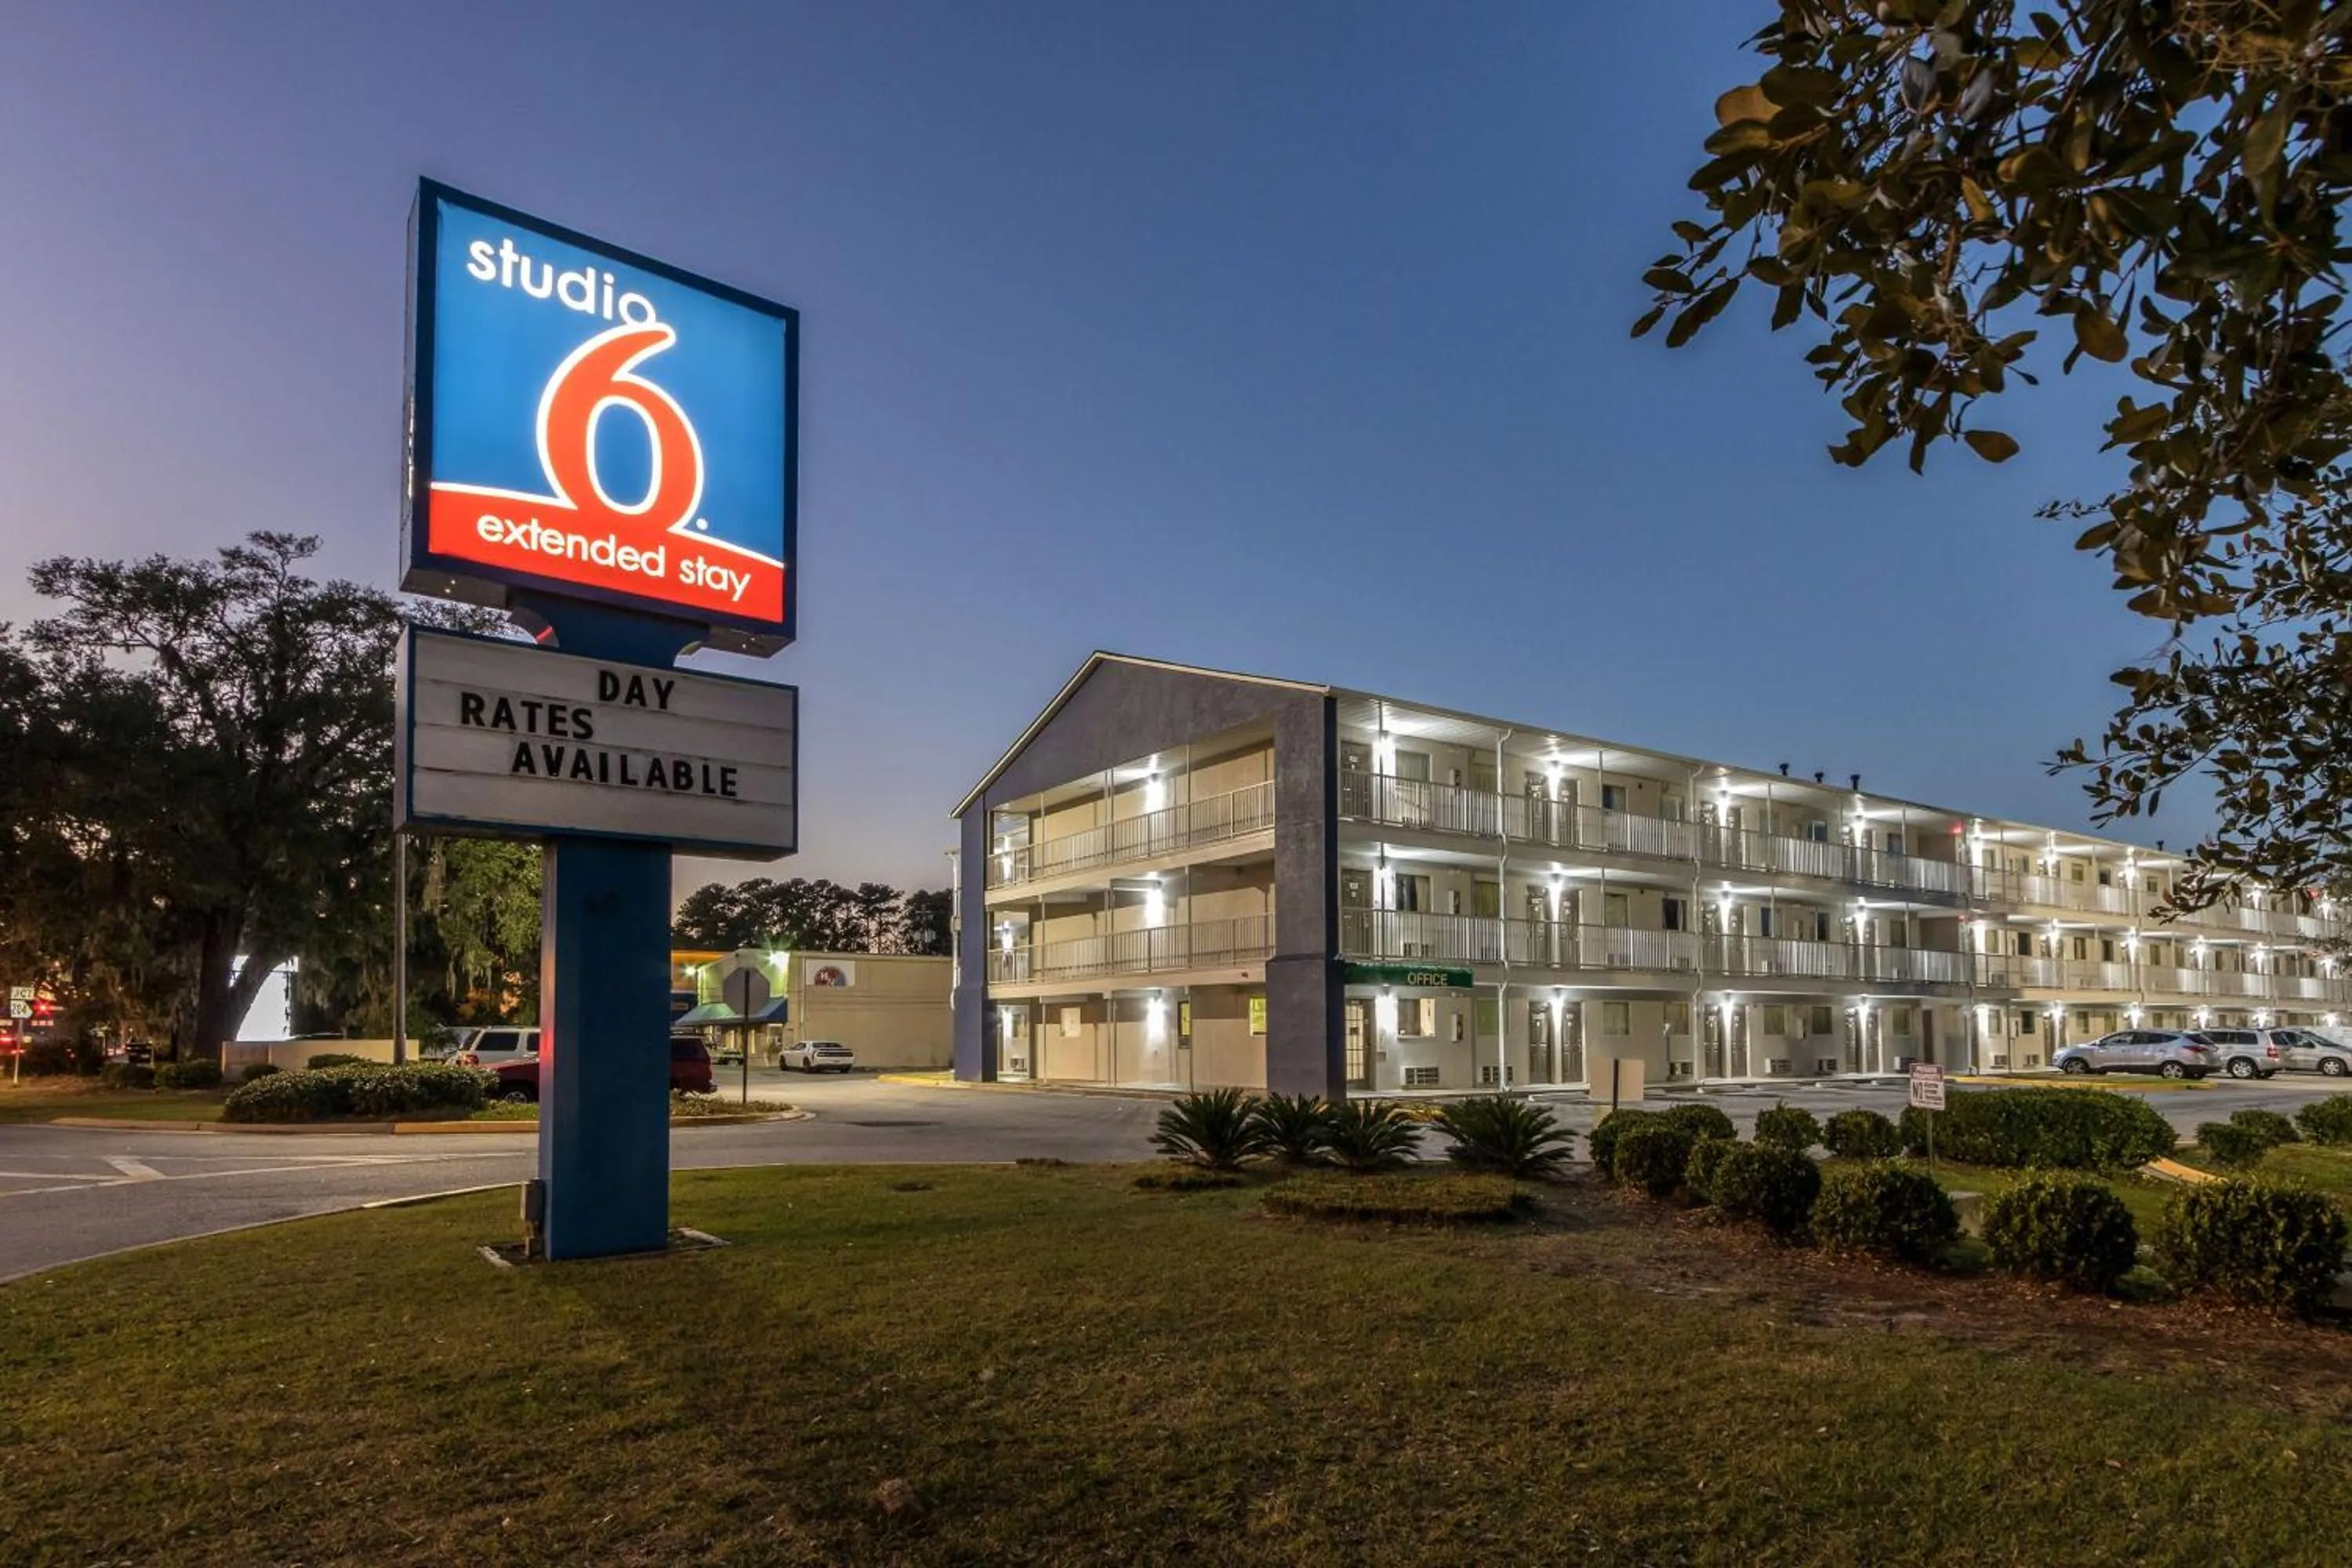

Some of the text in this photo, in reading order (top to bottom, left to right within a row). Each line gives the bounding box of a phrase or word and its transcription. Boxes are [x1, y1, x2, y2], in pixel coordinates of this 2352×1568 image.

[466, 238, 656, 326] studio
[477, 514, 751, 602] extended stay
[460, 691, 593, 739] RATES
[597, 670, 675, 710] DAY
[511, 742, 738, 797] AVAILABLE
[1407, 971, 1448, 985] OFFICE
